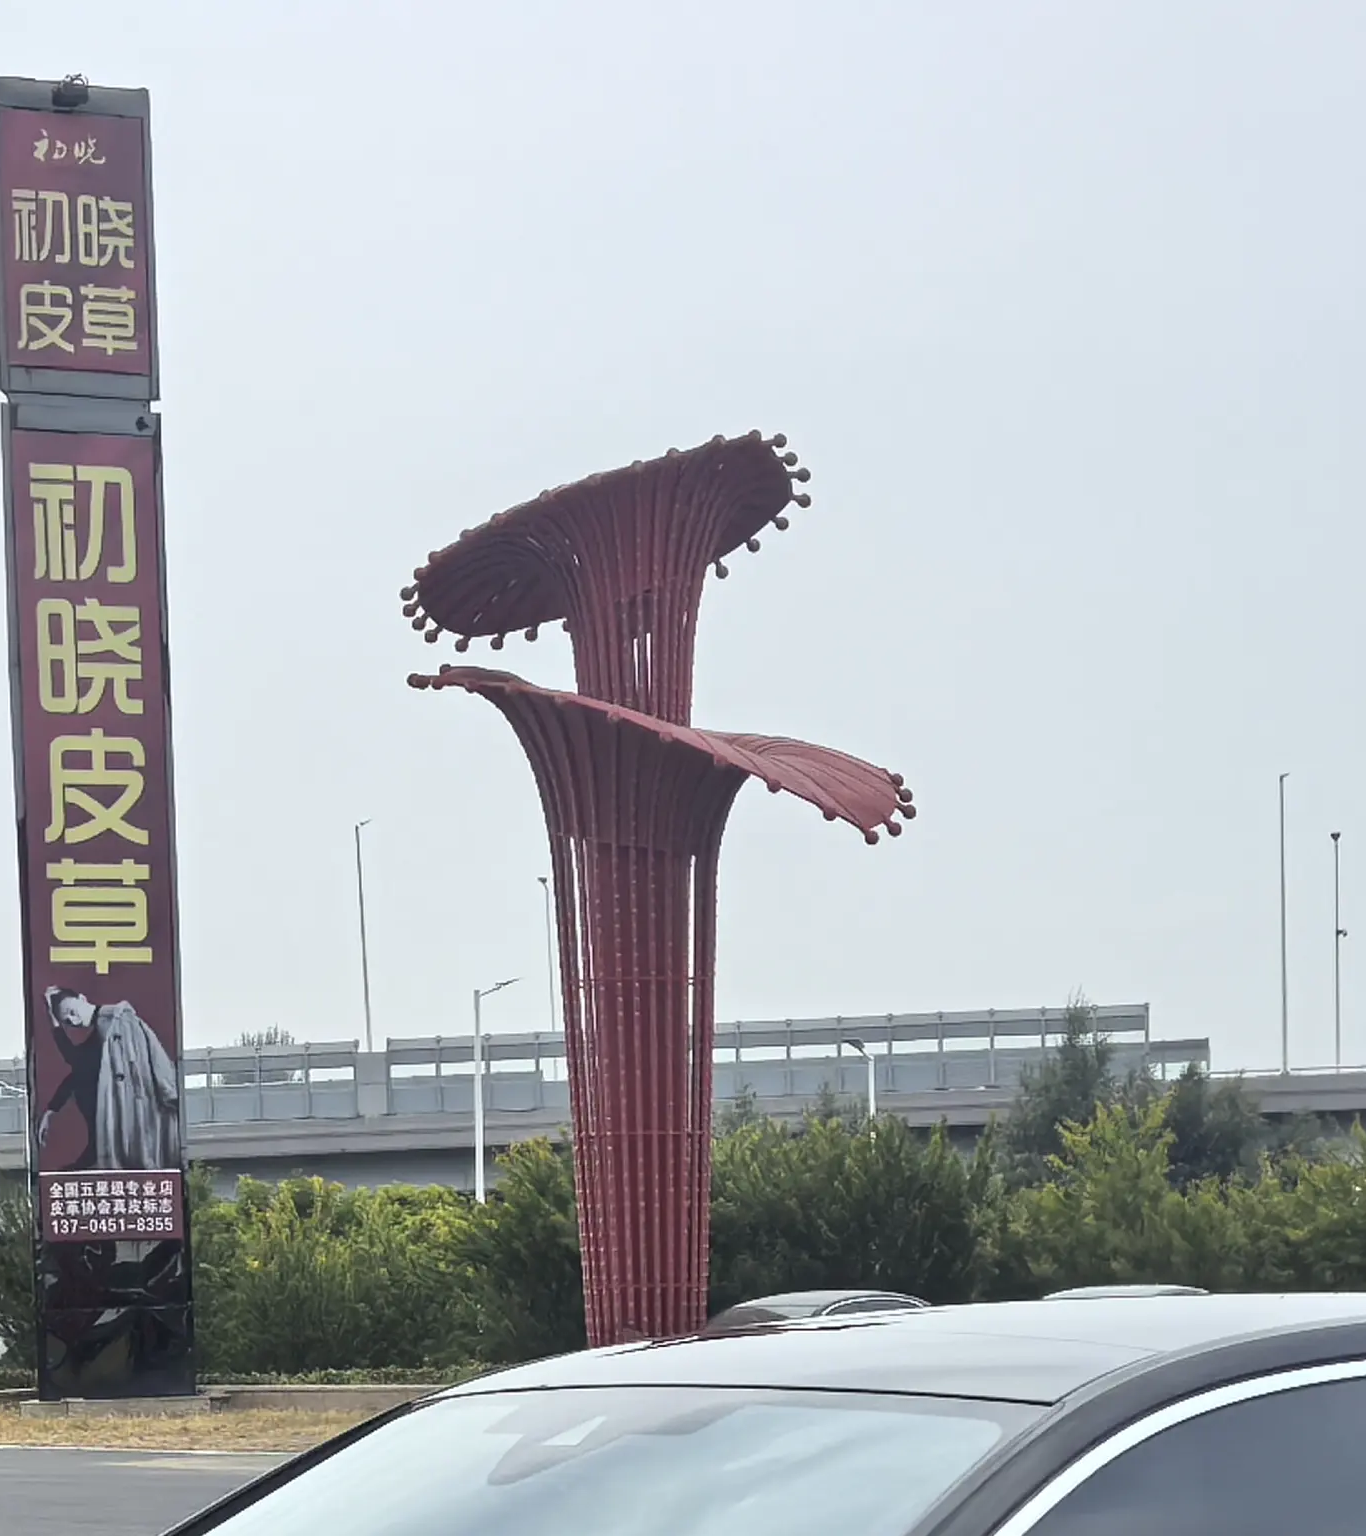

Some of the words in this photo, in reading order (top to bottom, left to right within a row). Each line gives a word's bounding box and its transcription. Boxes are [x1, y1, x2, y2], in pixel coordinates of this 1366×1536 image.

[33, 128, 106, 165] 初晓
[11, 188, 135, 269] 初晓
[17, 279, 139, 356] 皮草
[28, 462, 153, 974] 初晓皮草
[49, 1180, 173, 1198] 全国五星级专业店
[50, 1198, 173, 1216] 皮革协会真皮标志
[51, 1217, 173, 1235] 137-0451-8355
